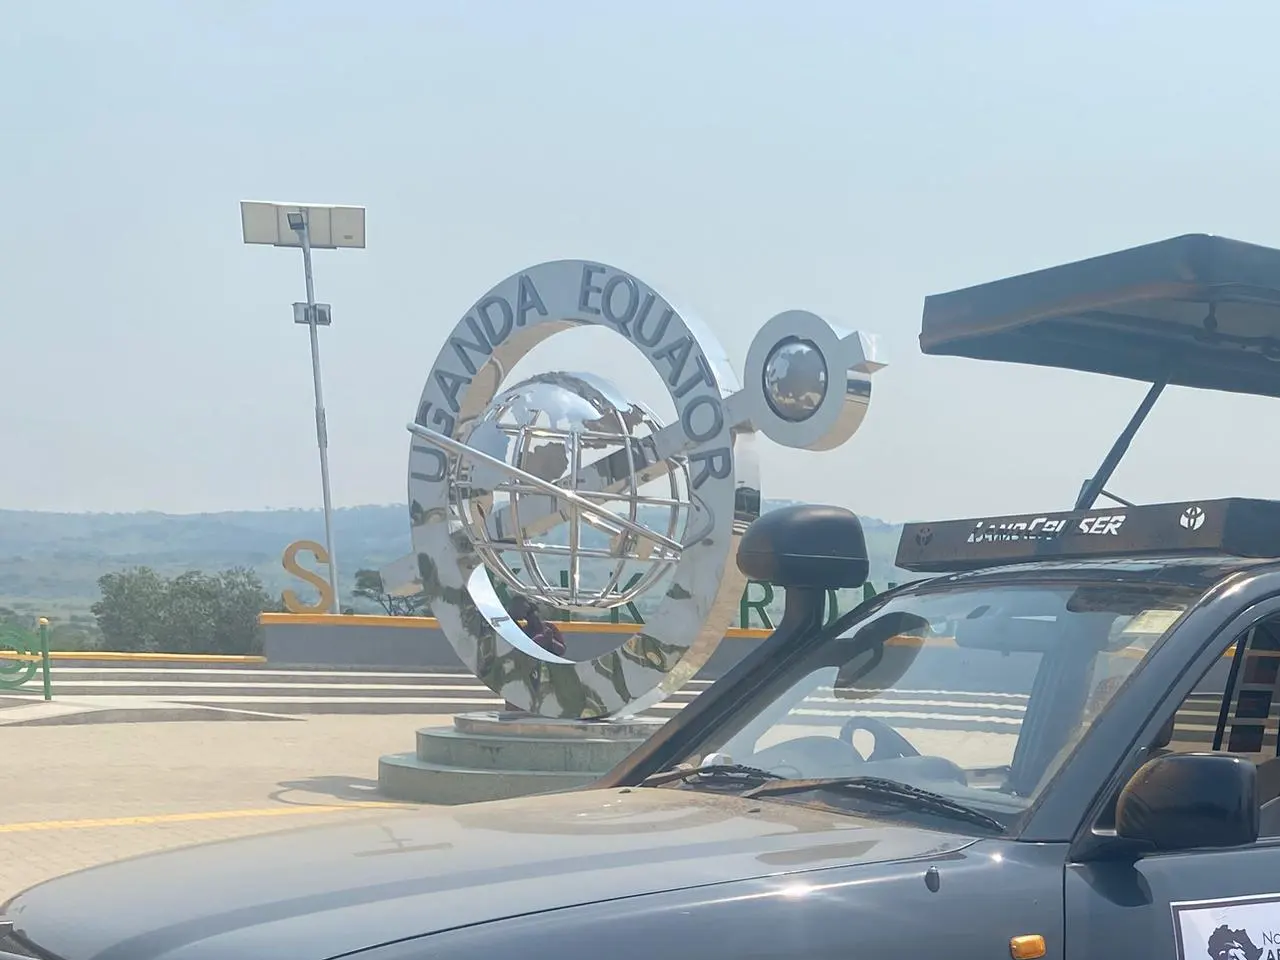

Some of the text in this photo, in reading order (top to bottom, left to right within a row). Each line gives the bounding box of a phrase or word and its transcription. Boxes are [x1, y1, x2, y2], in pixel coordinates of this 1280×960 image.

[410, 263, 732, 490] UGANDA EQUATOR
[282, 540, 335, 614] S
